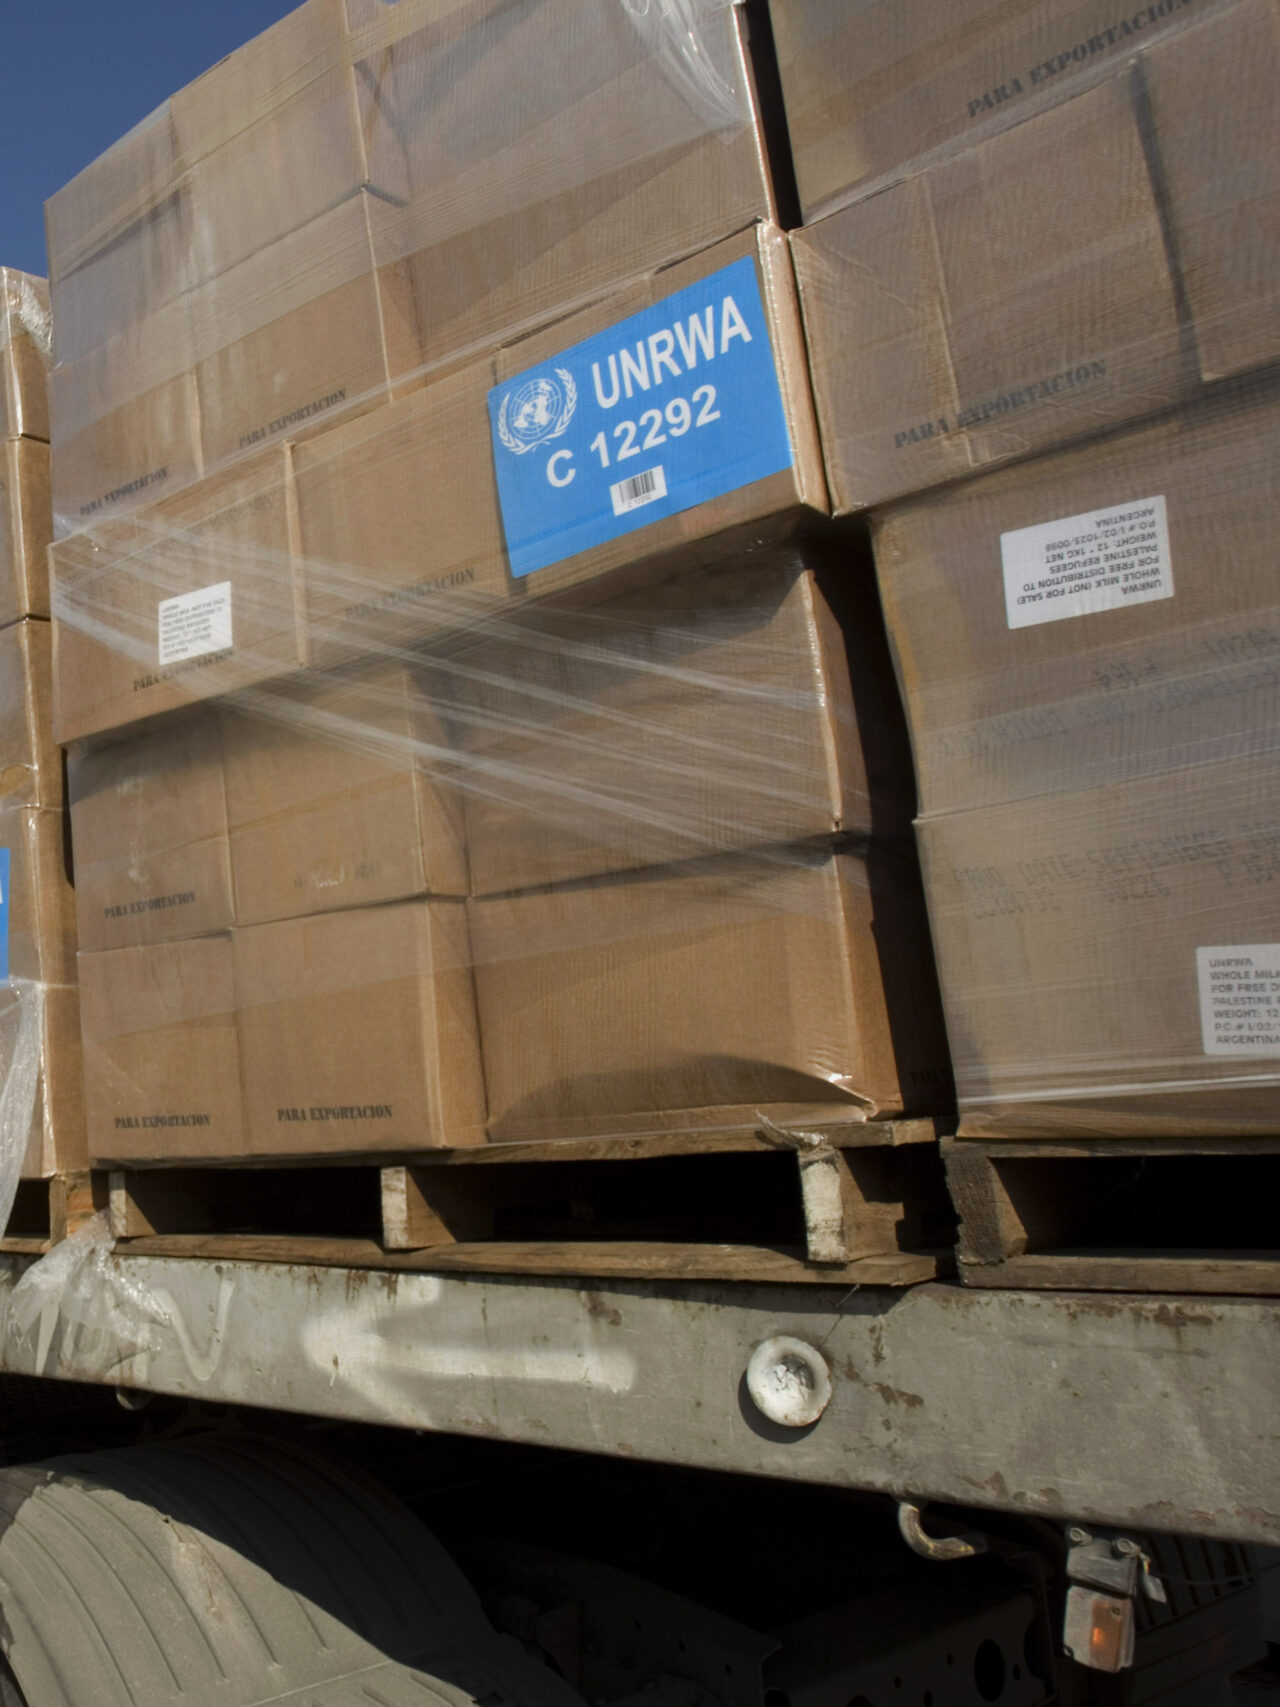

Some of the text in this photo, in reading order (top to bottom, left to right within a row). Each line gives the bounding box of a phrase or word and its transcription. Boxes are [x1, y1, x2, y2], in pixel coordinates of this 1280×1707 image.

[967, 0, 1191, 118] PARA EXPORTACIO
[591, 295, 753, 409] UNRWA
[239, 388, 347, 448] PARA EXPORTACION
[546, 384, 721, 488] C 12292
[894, 418, 950, 448] PARA
[1095, 507, 1155, 529] ARGENTINA
[1097, 542, 1109, 551] 12
[1045, 553, 1064, 564] NET
[1049, 543, 1158, 575] PALESTINE REFUGEES
[1023, 555, 1160, 592] FOR FREE DISTRIBUTION TO
[1123, 567, 1161, 583] WHOLE
[1095, 576, 1120, 589] MILK
[1121, 578, 1162, 595] UNRWA
[1046, 587, 1066, 599] FOR
[1209, 958, 1253, 968] UNRWA
[1210, 970, 1251, 980] WHOLE
[1211, 984, 1234, 993] FOR
[1237, 983, 1267, 992] FREE
[115, 1114, 211, 1129] PARA EXPORTACION
[278, 1105, 393, 1122] PARA EXPORTACION
